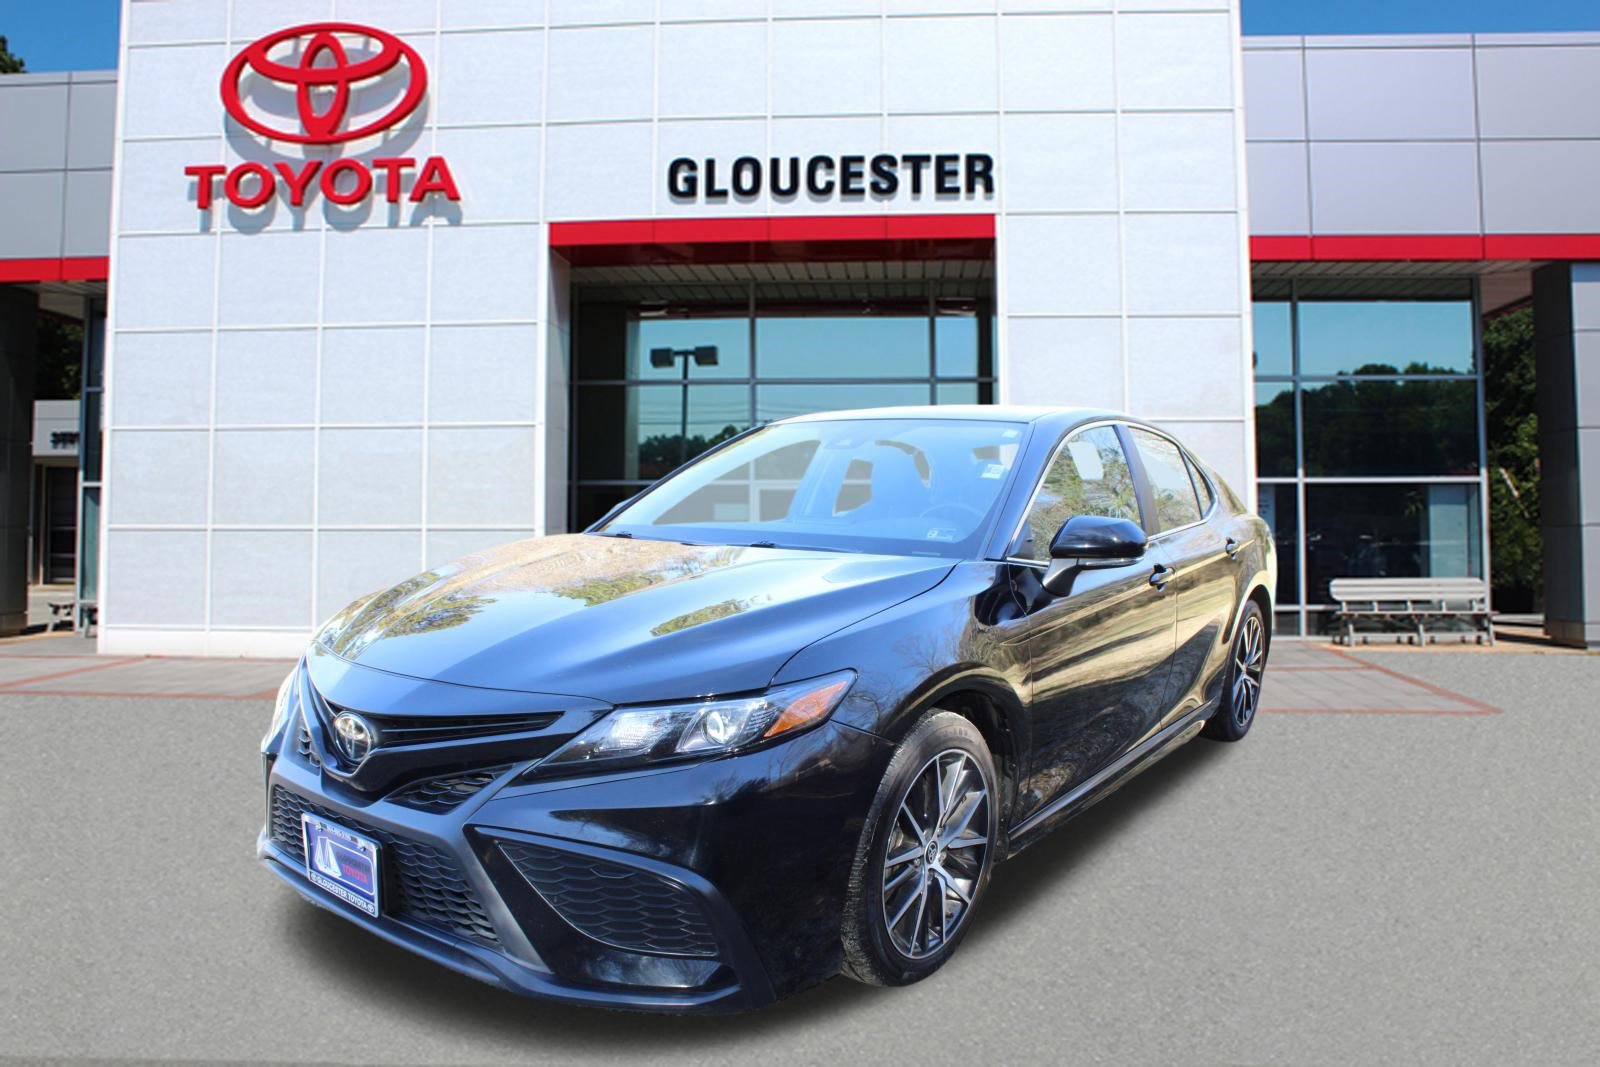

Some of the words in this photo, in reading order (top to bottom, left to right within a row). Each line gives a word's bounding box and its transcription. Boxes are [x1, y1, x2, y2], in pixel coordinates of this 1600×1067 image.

[185, 156, 461, 210] TOYOTA
[668, 153, 994, 198] GLOUCESTER
[347, 892, 367, 909] TOYOTA
